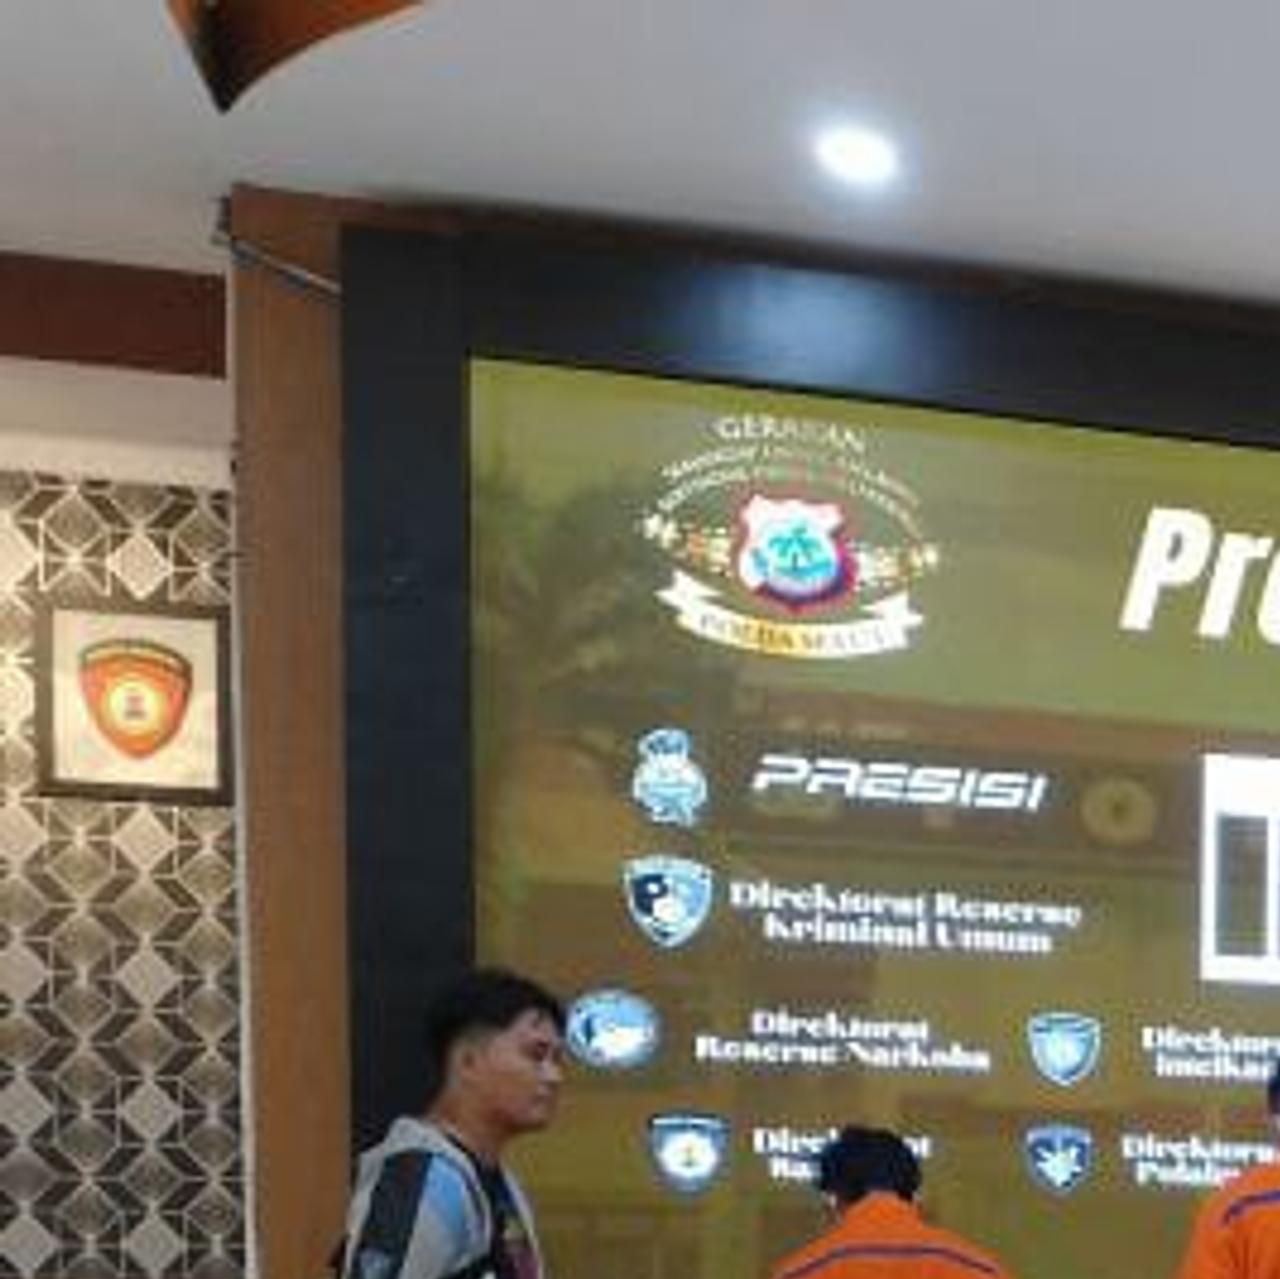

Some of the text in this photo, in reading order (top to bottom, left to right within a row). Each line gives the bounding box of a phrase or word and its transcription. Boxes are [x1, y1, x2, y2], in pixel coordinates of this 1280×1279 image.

[751, 754, 1049, 812] PRESISI
[764, 912, 1053, 953] Kriminal Umum
